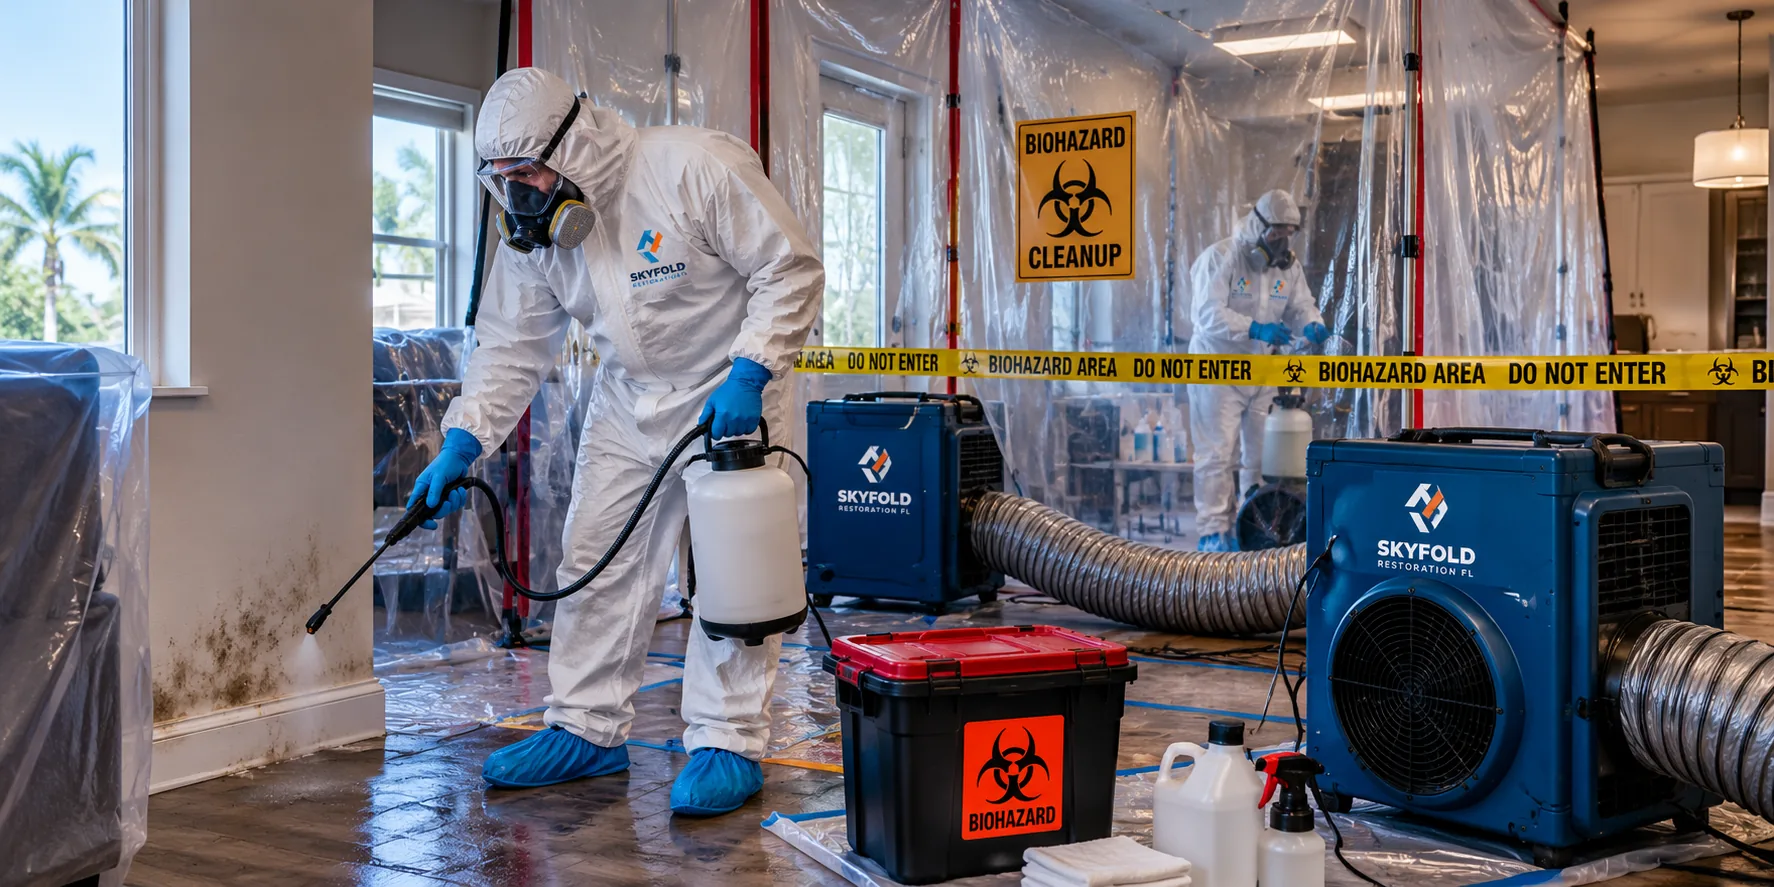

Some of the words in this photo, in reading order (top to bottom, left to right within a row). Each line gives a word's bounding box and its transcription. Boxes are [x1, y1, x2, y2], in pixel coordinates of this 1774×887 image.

[1025, 126, 1126, 155] BIOHAZARD
[1028, 243, 1122, 270] CLEANUP
[630, 262, 686, 282] SKYFOLD
[869, 352, 896, 371] NOT
[899, 353, 938, 372] ENTER
[988, 354, 1073, 376] BIOHAZARD
[1077, 357, 1118, 378] AREA
[1133, 358, 1155, 378] DO
[1161, 358, 1194, 379] NOT
[1199, 359, 1252, 381] ENTER
[1318, 361, 1427, 384] BIOHAZARD
[1433, 362, 1486, 384] AREA
[1508, 362, 1537, 384] DO
[1545, 362, 1588, 384] NOT
[1595, 361, 1666, 385] ENTER
[837, 489, 912, 506] SKYFOLD
[838, 505, 897, 514] RESTORATION
[1377, 539, 1476, 565] SKYFOLD
[1377, 559, 1456, 576] RESTORATION
[1461, 569, 1474, 578] FL
[969, 805, 1056, 832] BIOHAZARD
